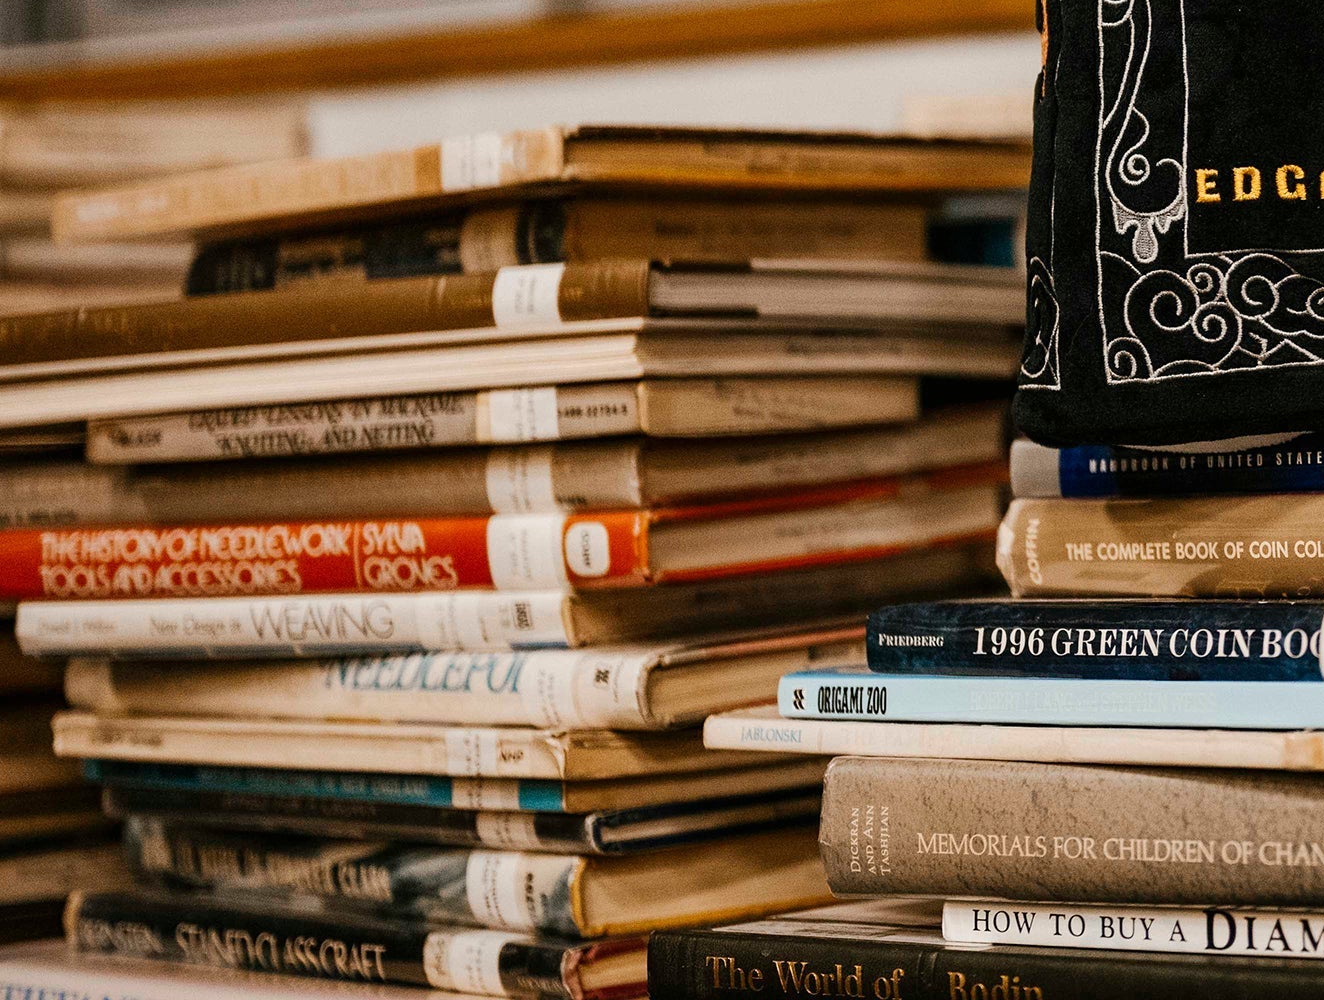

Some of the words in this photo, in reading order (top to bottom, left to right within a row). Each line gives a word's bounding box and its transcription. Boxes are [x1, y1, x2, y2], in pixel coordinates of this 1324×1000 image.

[322, 424, 356, 449] AND
[361, 418, 435, 445] NETTING
[1088, 458, 1169, 475] HANDBOOK
[1180, 456, 1197, 470] OF
[1207, 453, 1263, 469] UNITED
[40, 531, 82, 562] THE
[82, 528, 164, 562] HISTORY
[165, 527, 200, 560] OF
[200, 522, 353, 559] NEEDLEWORK
[1026, 519, 1042, 585] COFFIN
[1066, 543, 1094, 560] THE
[1096, 542, 1171, 560] COMPLETE
[1175, 541, 1219, 559] BOOK
[1224, 541, 1244, 558] OF
[1249, 540, 1289, 558] COIN
[39, 564, 111, 596] TOOLS
[112, 563, 152, 595] AND
[154, 559, 300, 595] ACCESSORIES
[363, 556, 460, 589] GROVES
[250, 600, 394, 640] WEAVING
[878, 633, 944, 648] FRIEDBERG
[972, 627, 1045, 656] 1996
[1052, 628, 1161, 658] GREEN
[1168, 628, 1254, 659] COIN
[817, 687, 864, 715] ORIGAMI
[867, 686, 887, 715] ZOO
[740, 726, 802, 744] JABLONSKI
[863, 805, 874, 839] ANN
[851, 807, 861, 872] DICKRAN
[880, 806, 891, 876] TASHJIAN
[917, 832, 1047, 859] MEMORIALS
[1053, 836, 1097, 859] FOR
[1103, 837, 1216, 864] CHILDREN
[1221, 839, 1254, 864] OF
[866, 845, 877, 875] AND
[972, 909, 1037, 935] HOW
[1049, 912, 1086, 937] TO
[1099, 915, 1155, 940] BUY
[1169, 918, 1187, 942] A
[320, 937, 387, 980] CRAFT
[705, 956, 764, 993] The
[772, 959, 864, 998] World
[874, 968, 905, 1000] of
[947, 971, 1043, 1000] Rodin
